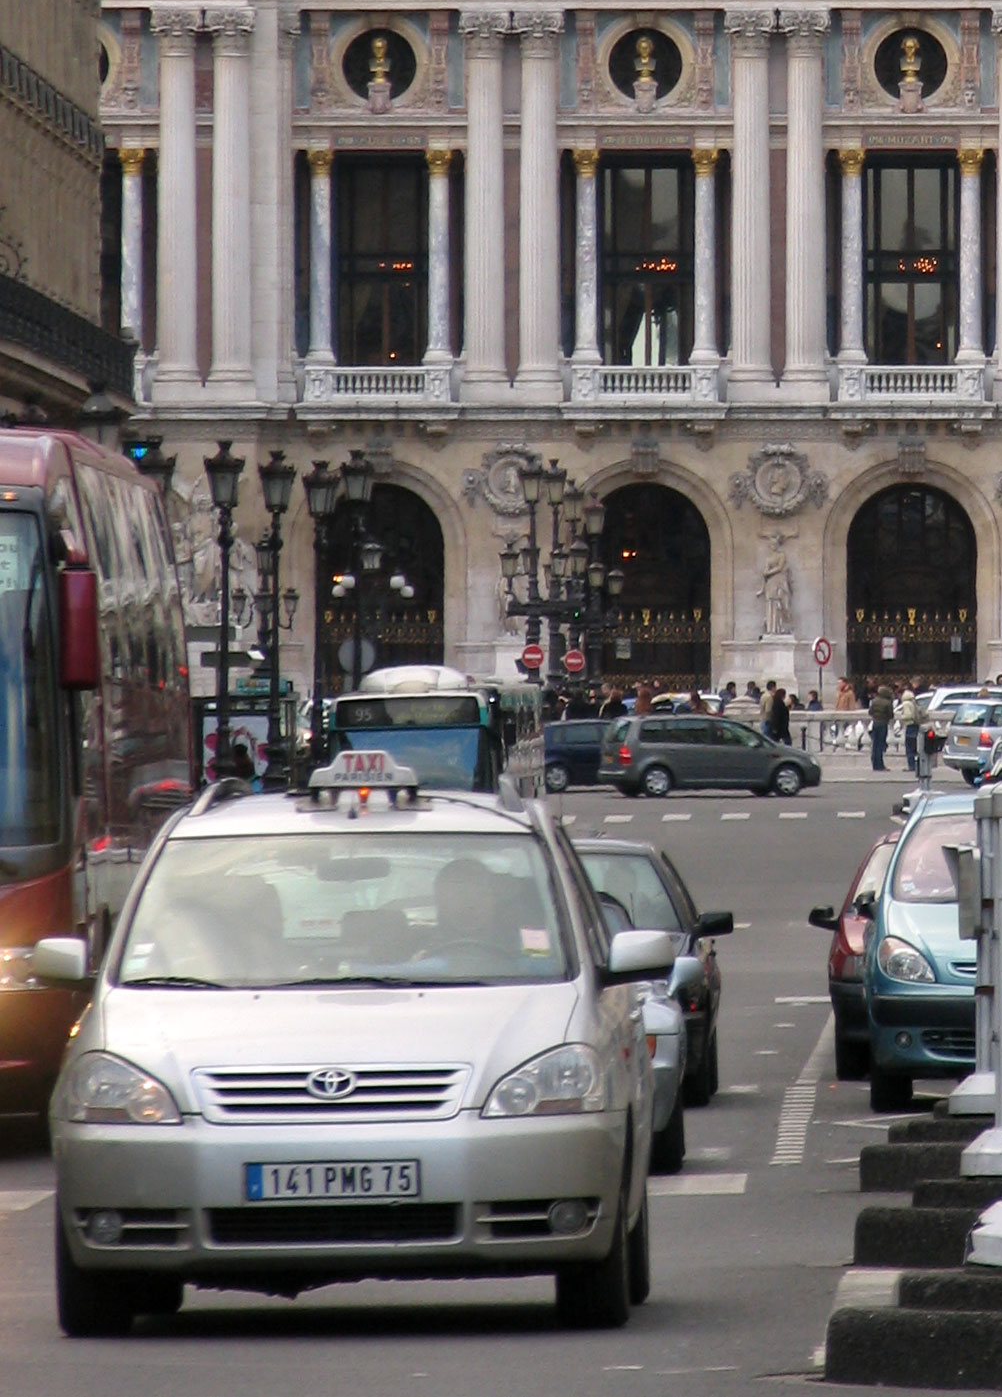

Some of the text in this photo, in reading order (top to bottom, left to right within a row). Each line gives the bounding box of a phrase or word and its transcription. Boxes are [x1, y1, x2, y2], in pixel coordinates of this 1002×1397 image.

[355, 707, 373, 722] 95
[343, 753, 385, 773] TAXI
[334, 772, 393, 782] PARISIEN
[270, 1165, 411, 1196] 141 PMG 75
